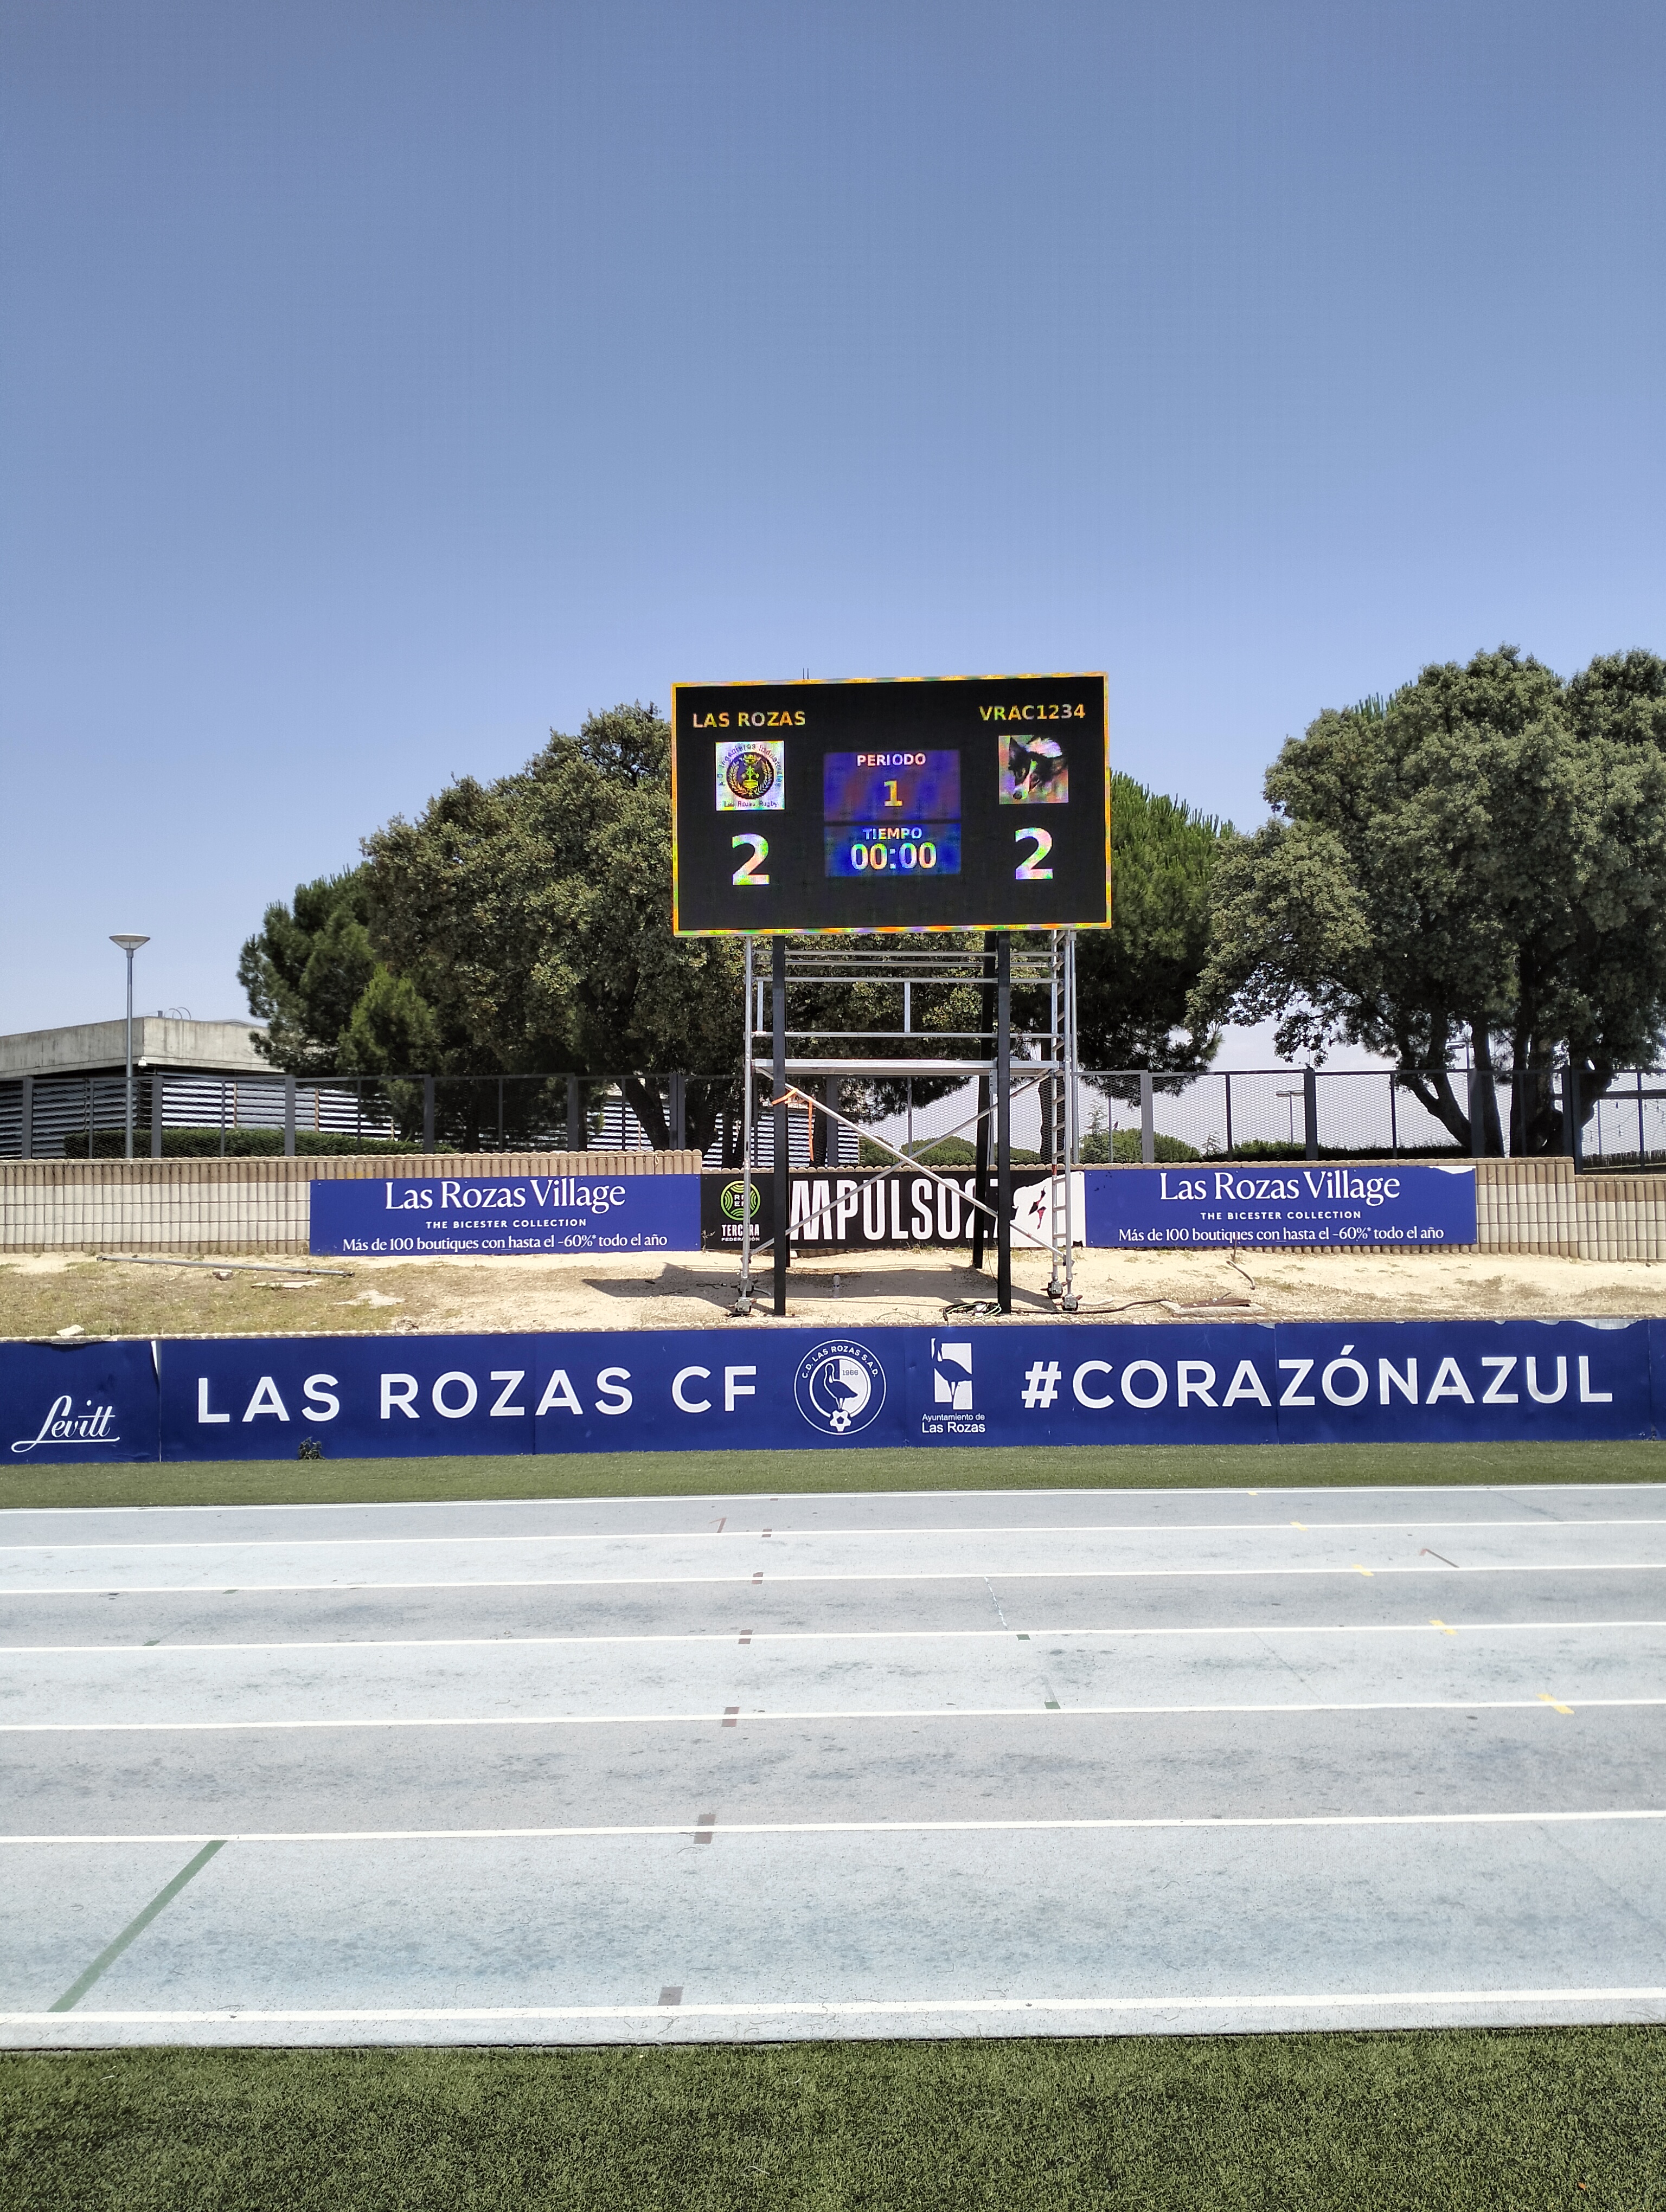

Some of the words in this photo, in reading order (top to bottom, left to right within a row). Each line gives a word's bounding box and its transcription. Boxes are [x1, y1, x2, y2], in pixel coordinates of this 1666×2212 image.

[693, 712, 730, 728] LAS
[739, 711, 806, 727] ROZAS
[979, 704, 1085, 721] VRAC1234
[856, 753, 926, 767] PERIODO
[883, 780, 902, 807] 1
[862, 827, 922, 840] TIEMPO
[732, 833, 770, 885] 2
[850, 843, 937, 870] 00:00
[1015, 827, 1053, 880] 2
[386, 1182, 433, 1210] Las
[441, 1181, 526, 1208] Rozas
[530, 1178, 626, 1214] Village
[1160, 1172, 1207, 1200] Las
[1214, 1171, 1299, 1200] Rozas
[1303, 1169, 1400, 1206] Village
[426, 1221, 447, 1229] THE
[453, 1220, 508, 1229] BICESTER
[513, 1218, 586, 1227] COLLECTION
[1227, 1212, 1282, 1220] BICESTER
[1287, 1211, 1361, 1219] COLLECTION
[721, 1224, 760, 1237] TERCRA
[1119, 1229, 1144, 1241] Más
[1147, 1228, 1163, 1241] de
[1165, 1228, 1189, 1241] 100
[1193, 1227, 1254, 1244] boutiques
[1257, 1230, 1280, 1240] con
[1283, 1227, 1316, 1240] hasta
[1318, 1227, 1329, 1240] el
[1374, 1226, 1404, 1239] todo
[1406, 1226, 1418, 1239] el
[1420, 1226, 1444, 1239] año
[343, 1238, 368, 1251] Más
[371, 1238, 387, 1251] de
[390, 1238, 414, 1250] 100
[417, 1237, 479, 1252] boutiques
[482, 1239, 505, 1249] con
[508, 1236, 541, 1249] hasta
[544, 1235, 554, 1248] el
[599, 1234, 629, 1247] todo
[631, 1233, 642, 1246] el
[644, 1233, 668, 1246] año
[802, 1363, 814, 1378] C.D.
[812, 1348, 828, 1362] LAS
[831, 1345, 861, 1356] ROZAS
[861, 1354, 878, 1377] S.A.D.
[1021, 1345, 1613, 1409] #CORAZÓNAZUL
[198, 1373, 340, 1423] LAS
[380, 1367, 633, 1419] ROZAS
[672, 1366, 757, 1413] CF
[11, 1395, 120, 1453] Levitt
[922, 1412, 973, 1423] Ayuntamiento
[922, 1422, 944, 1433] Las
[948, 1421, 985, 1433] Rozas
